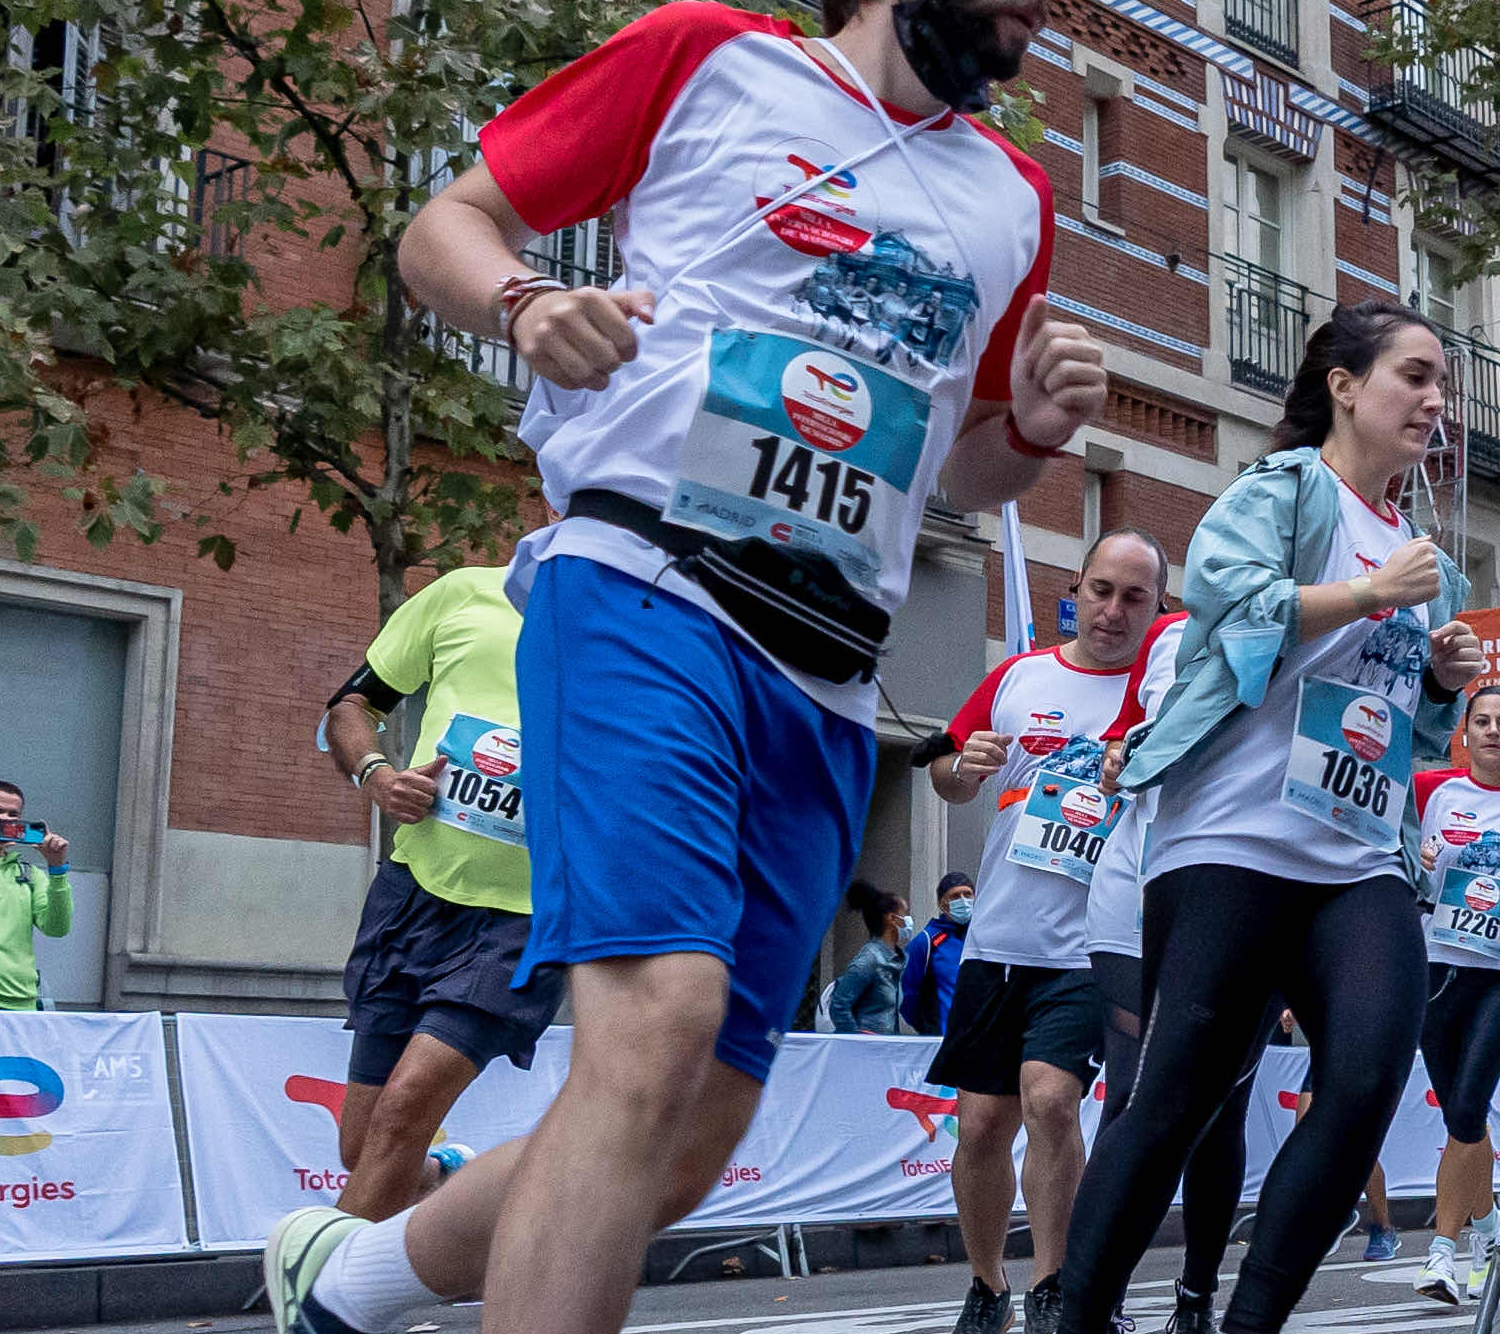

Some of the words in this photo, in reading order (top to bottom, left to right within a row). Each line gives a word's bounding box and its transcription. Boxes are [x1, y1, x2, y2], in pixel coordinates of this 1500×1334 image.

[749, 434, 875, 535] 1415
[446, 768, 522, 821] 1054
[1320, 749, 1391, 817] 1036
[1039, 821, 1106, 865] 1040
[1450, 907, 1500, 940] 1226
